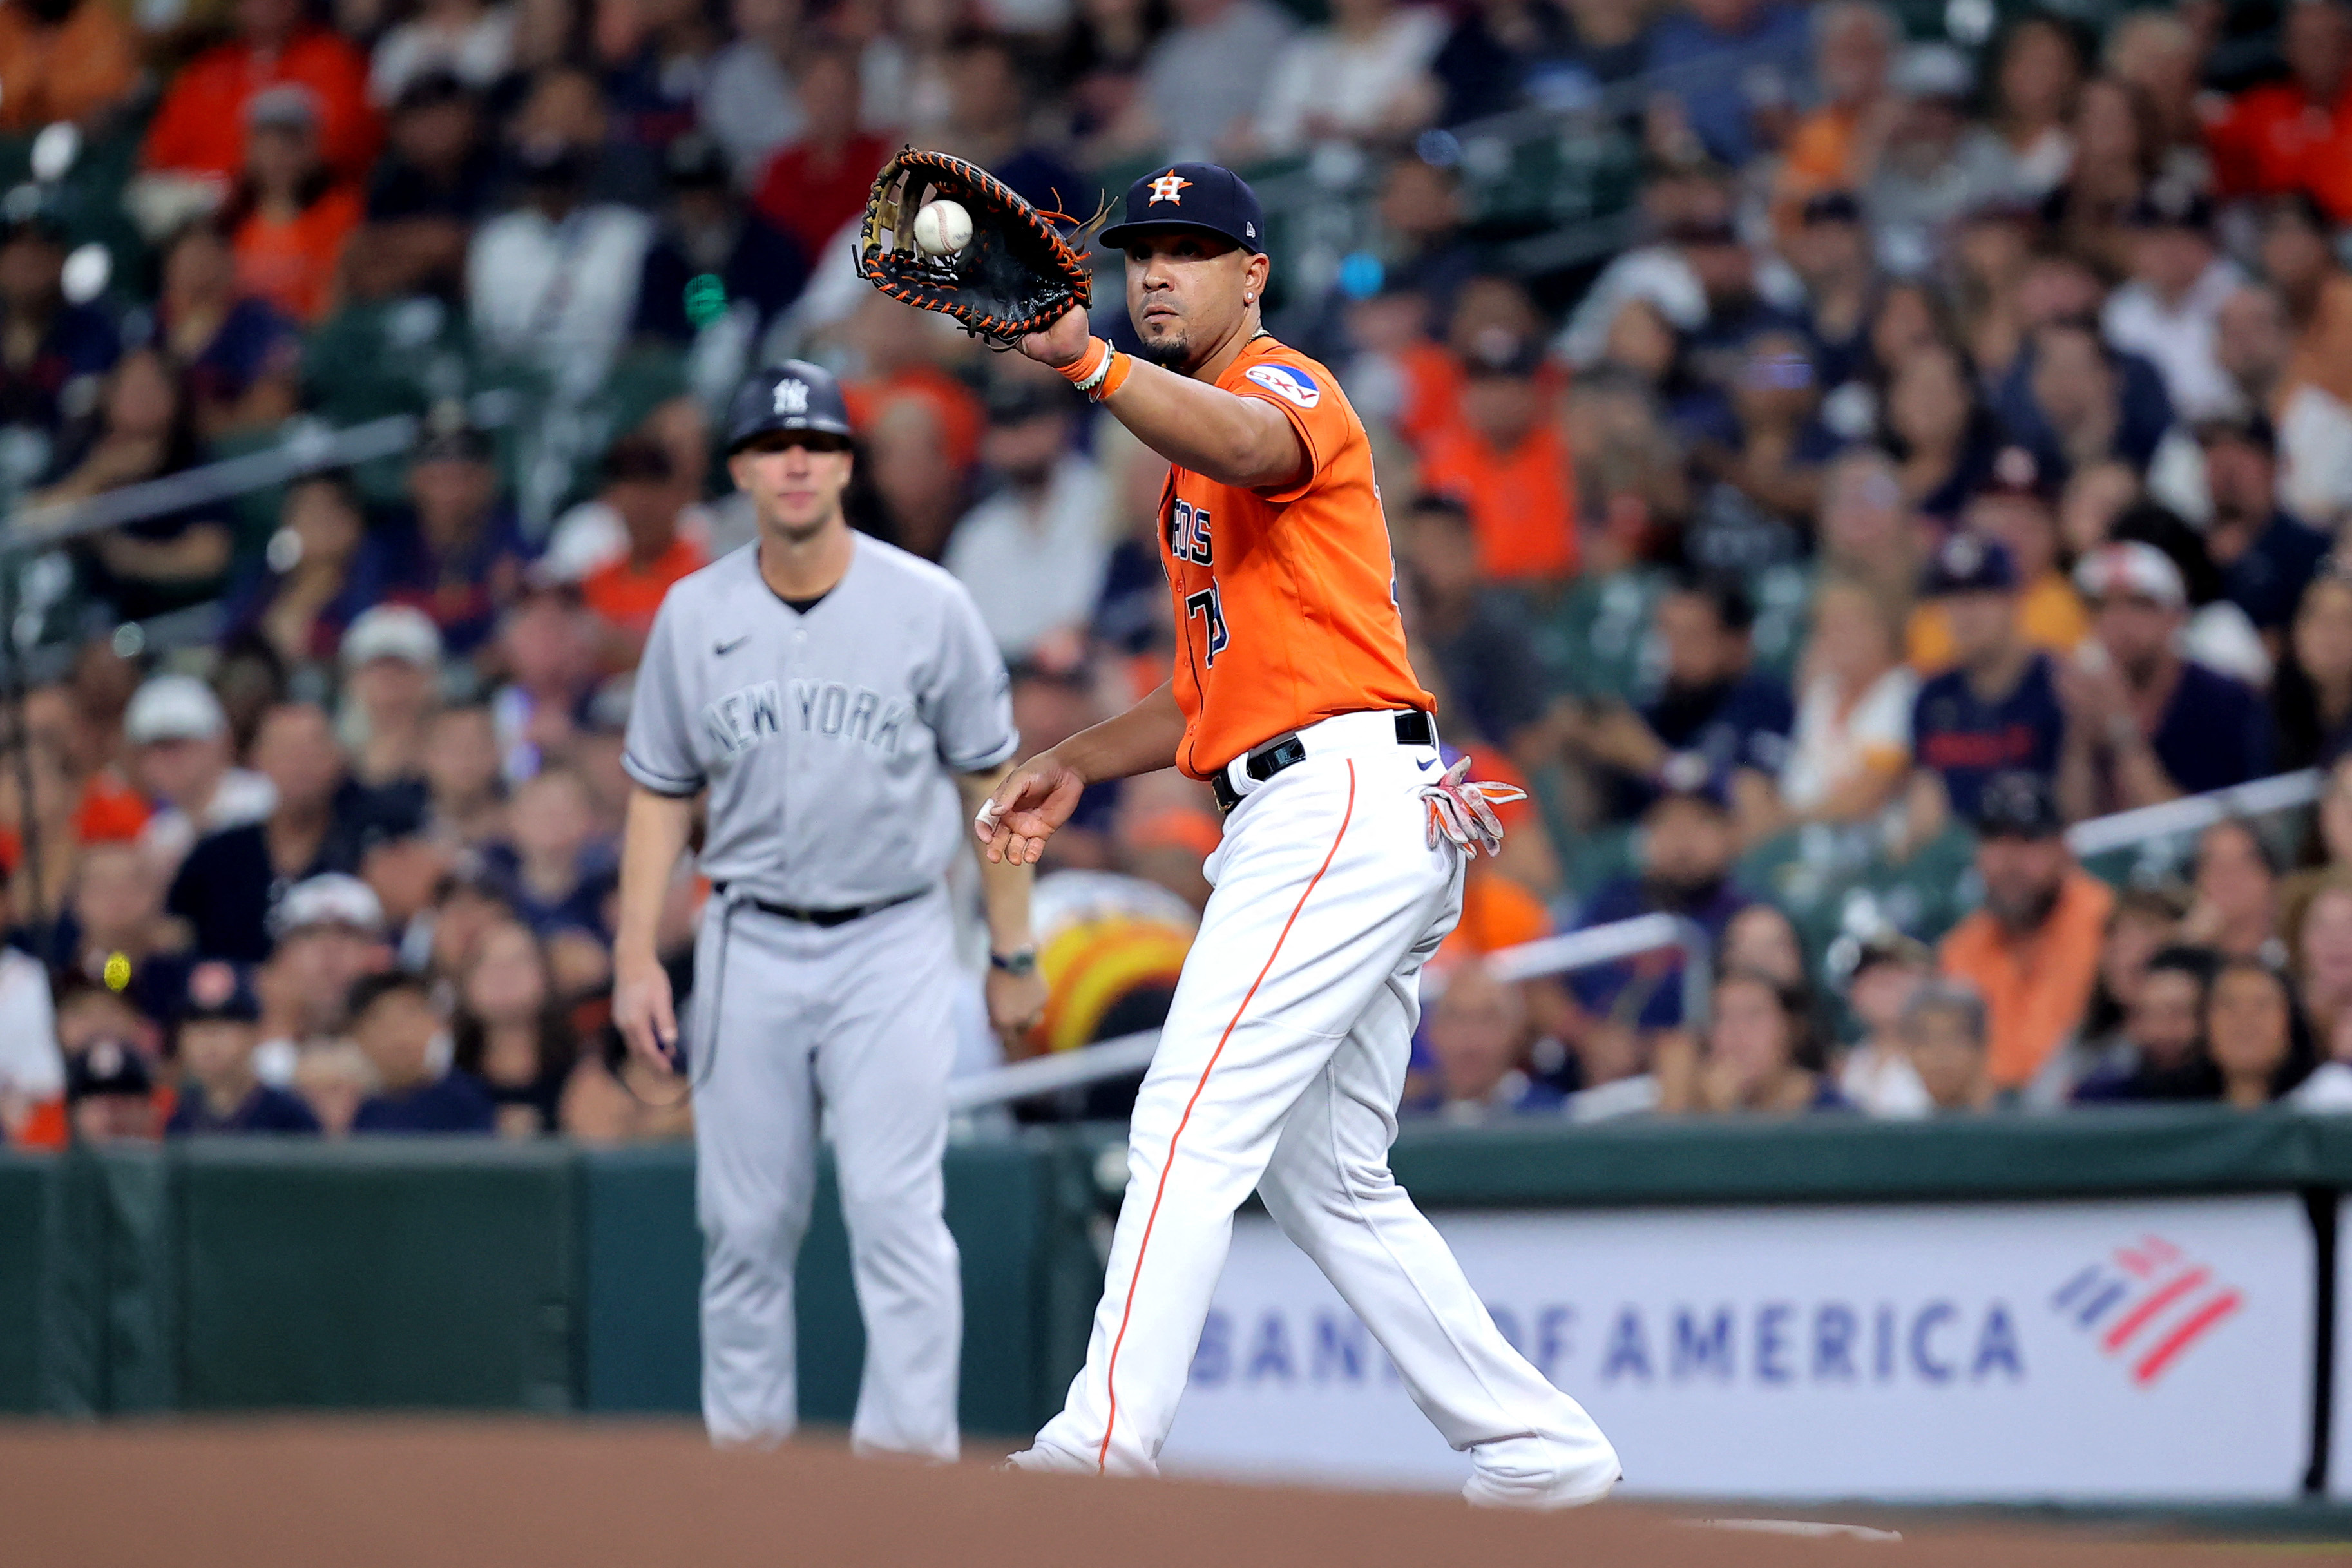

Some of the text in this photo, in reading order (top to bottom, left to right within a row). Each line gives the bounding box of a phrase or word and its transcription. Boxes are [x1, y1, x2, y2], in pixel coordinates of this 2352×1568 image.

[1149, 176, 1185, 202] H
[772, 378, 810, 415] NY
[1248, 370, 1317, 399] OXY
[702, 680, 780, 755] NEW
[789, 678, 911, 755] YORK
[1187, 1303, 1404, 1385] BAN
[1600, 1301, 2024, 1385] AMERICA
